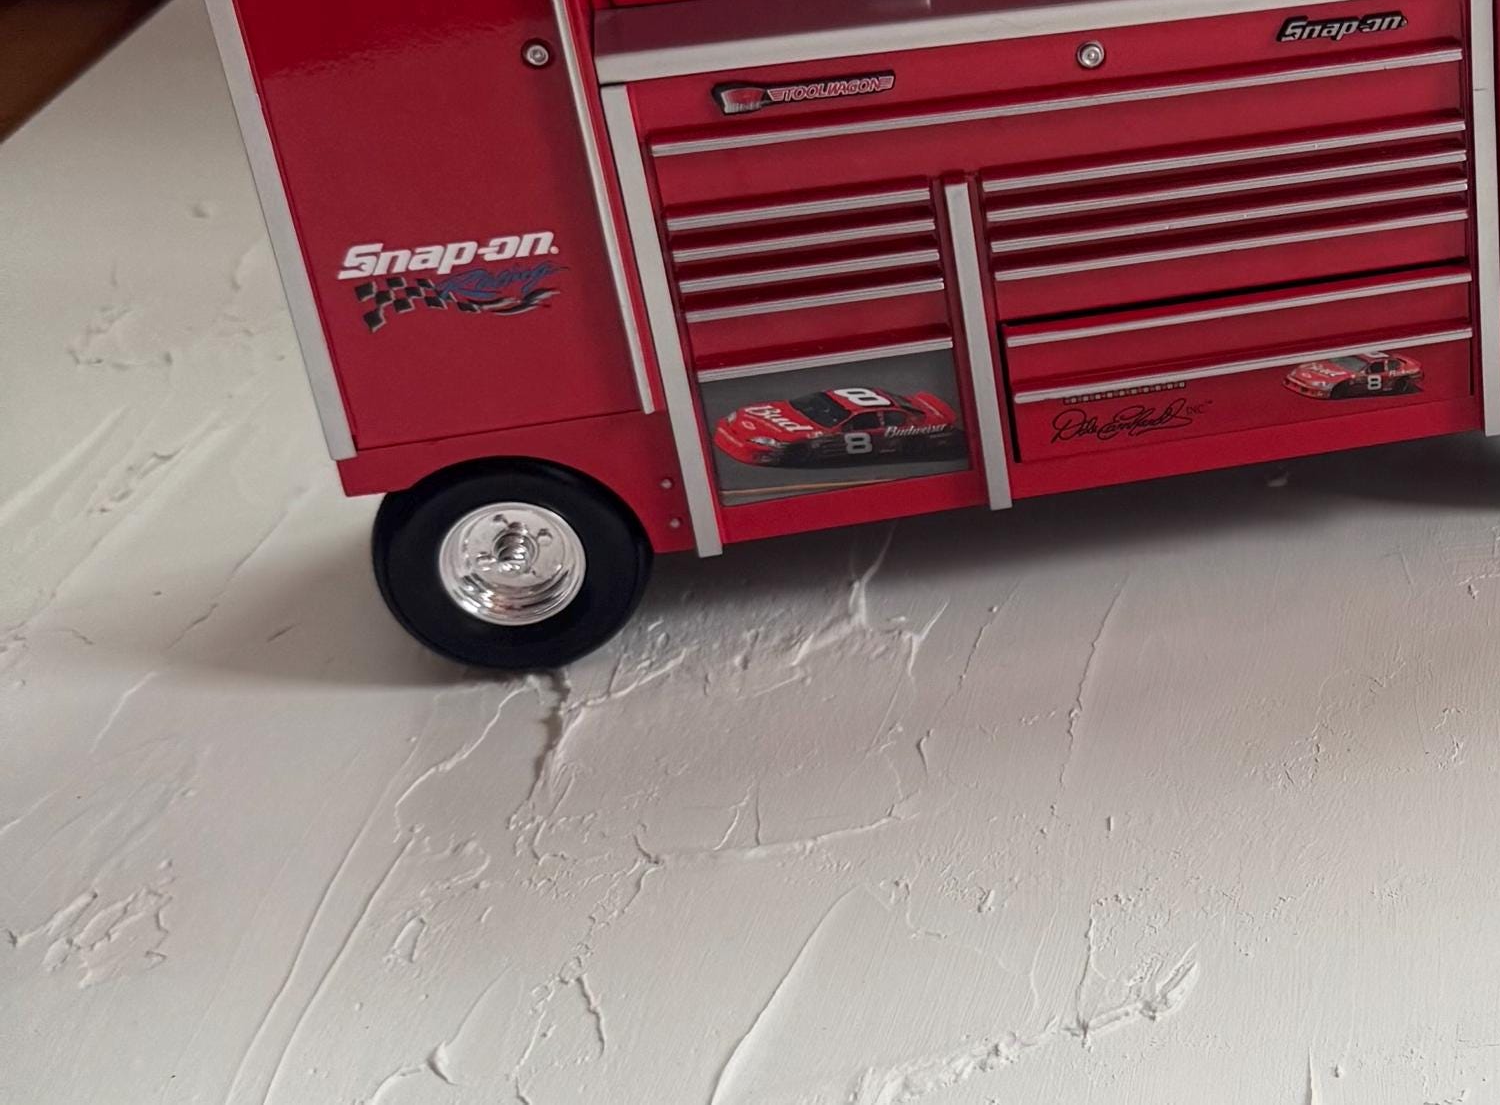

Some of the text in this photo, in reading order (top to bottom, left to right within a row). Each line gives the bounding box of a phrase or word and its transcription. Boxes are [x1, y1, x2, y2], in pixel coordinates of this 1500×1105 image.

[1279, 13, 1408, 43] Snap-on
[1367, 374, 1382, 391] 8
[832, 387, 893, 407] 8
[744, 404, 813, 433] Bud
[884, 422, 948, 438] Budweiser
[844, 432, 873, 455] 8
